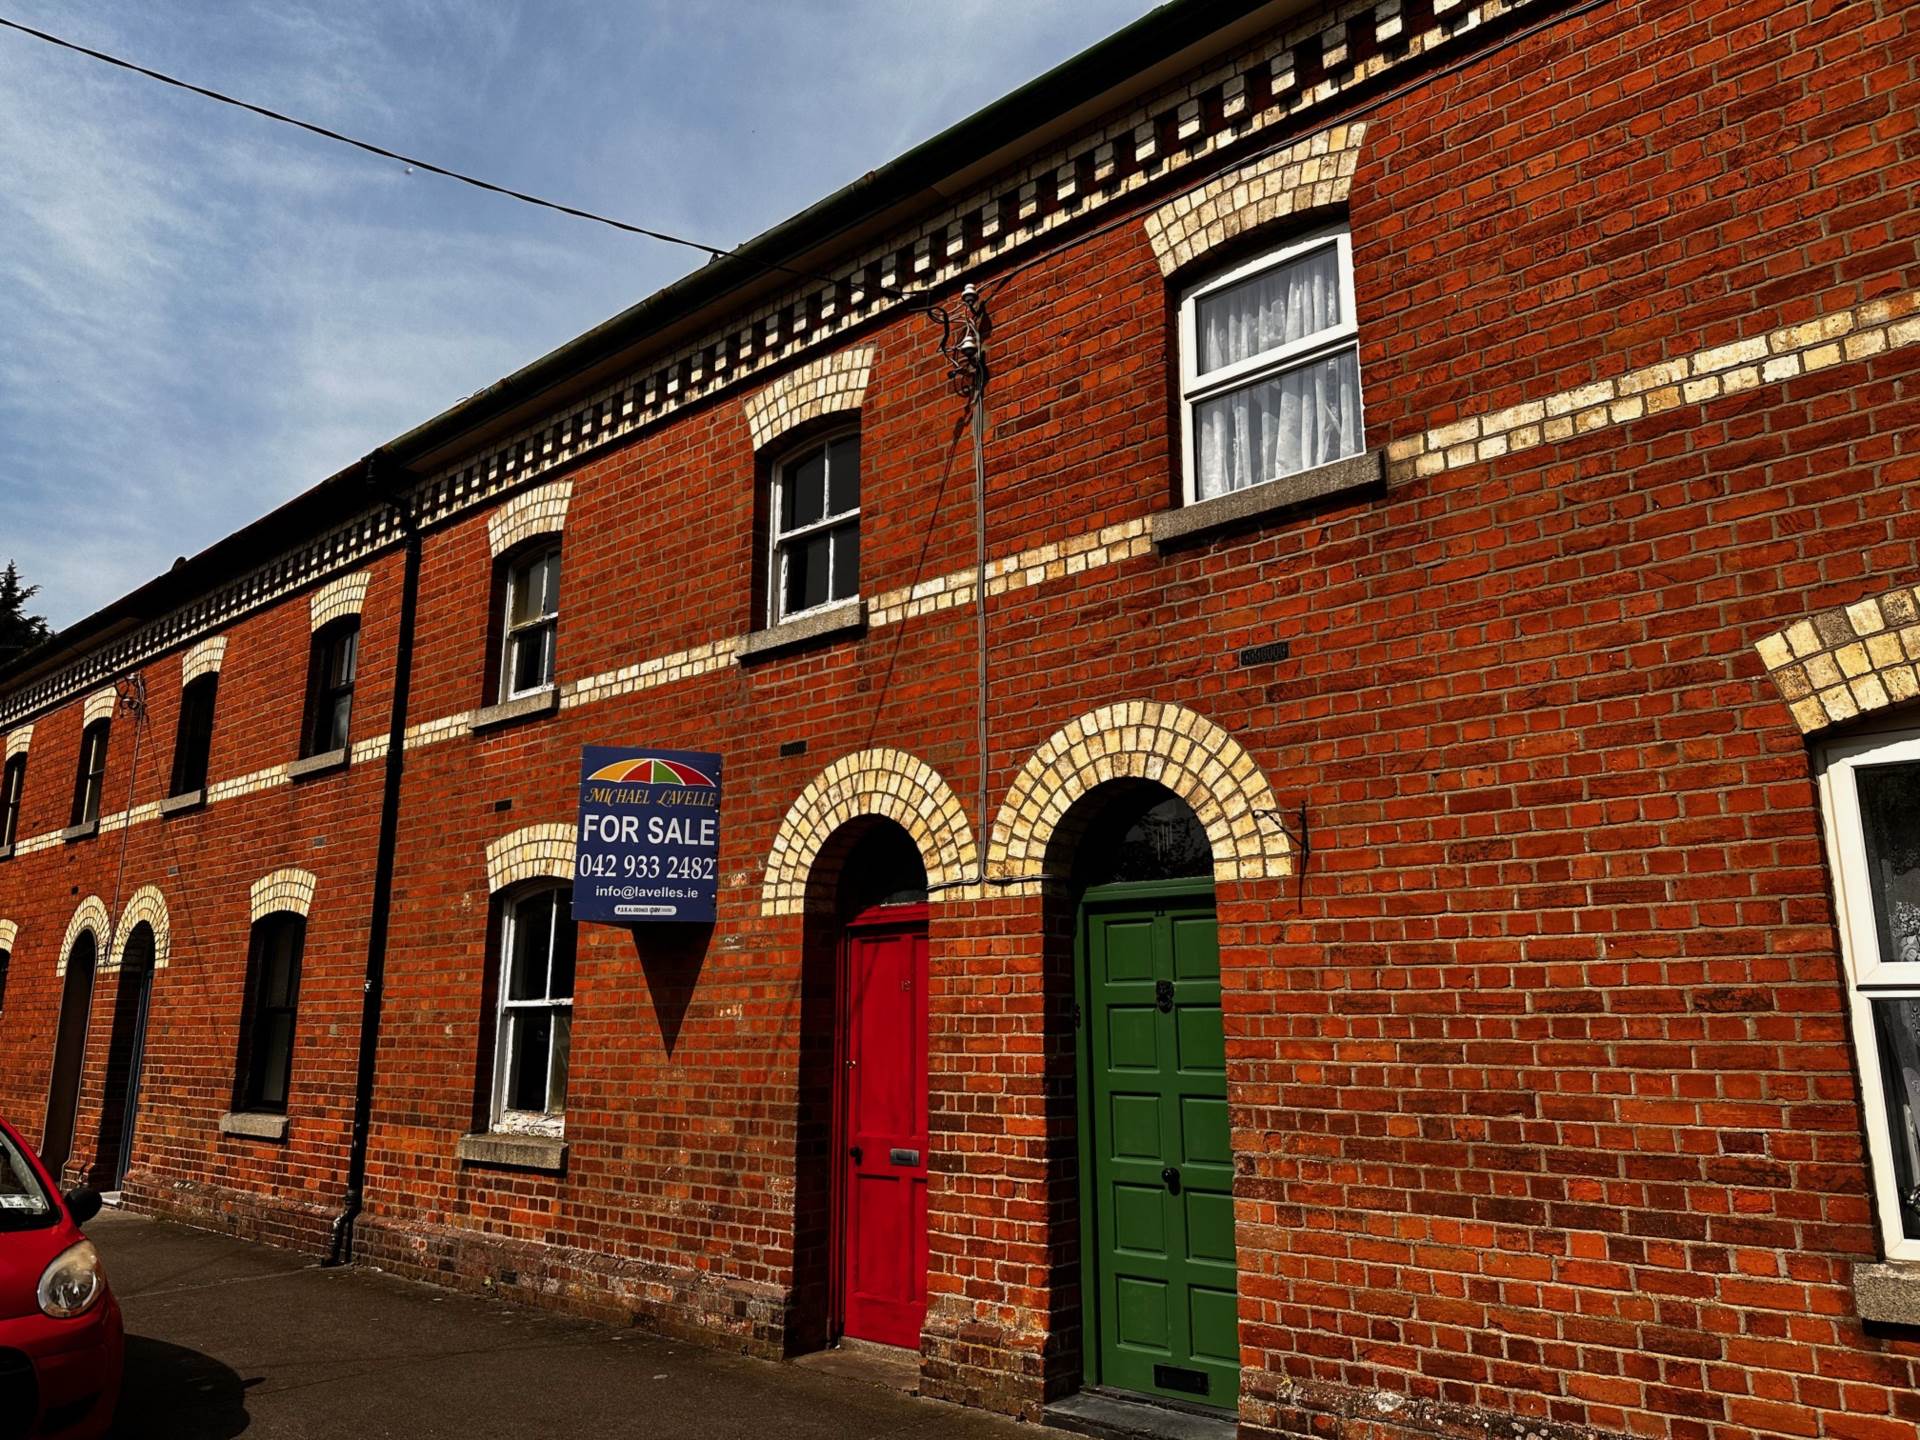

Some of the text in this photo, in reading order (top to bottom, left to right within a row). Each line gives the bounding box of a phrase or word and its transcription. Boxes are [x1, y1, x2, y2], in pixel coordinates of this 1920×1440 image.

[584, 787, 716, 807] MICHAEL LAVELLE
[583, 814, 715, 845] FOR SALE
[579, 854, 714, 880] 042 933 2482
[596, 886, 698, 899] info@lavelles.ie
